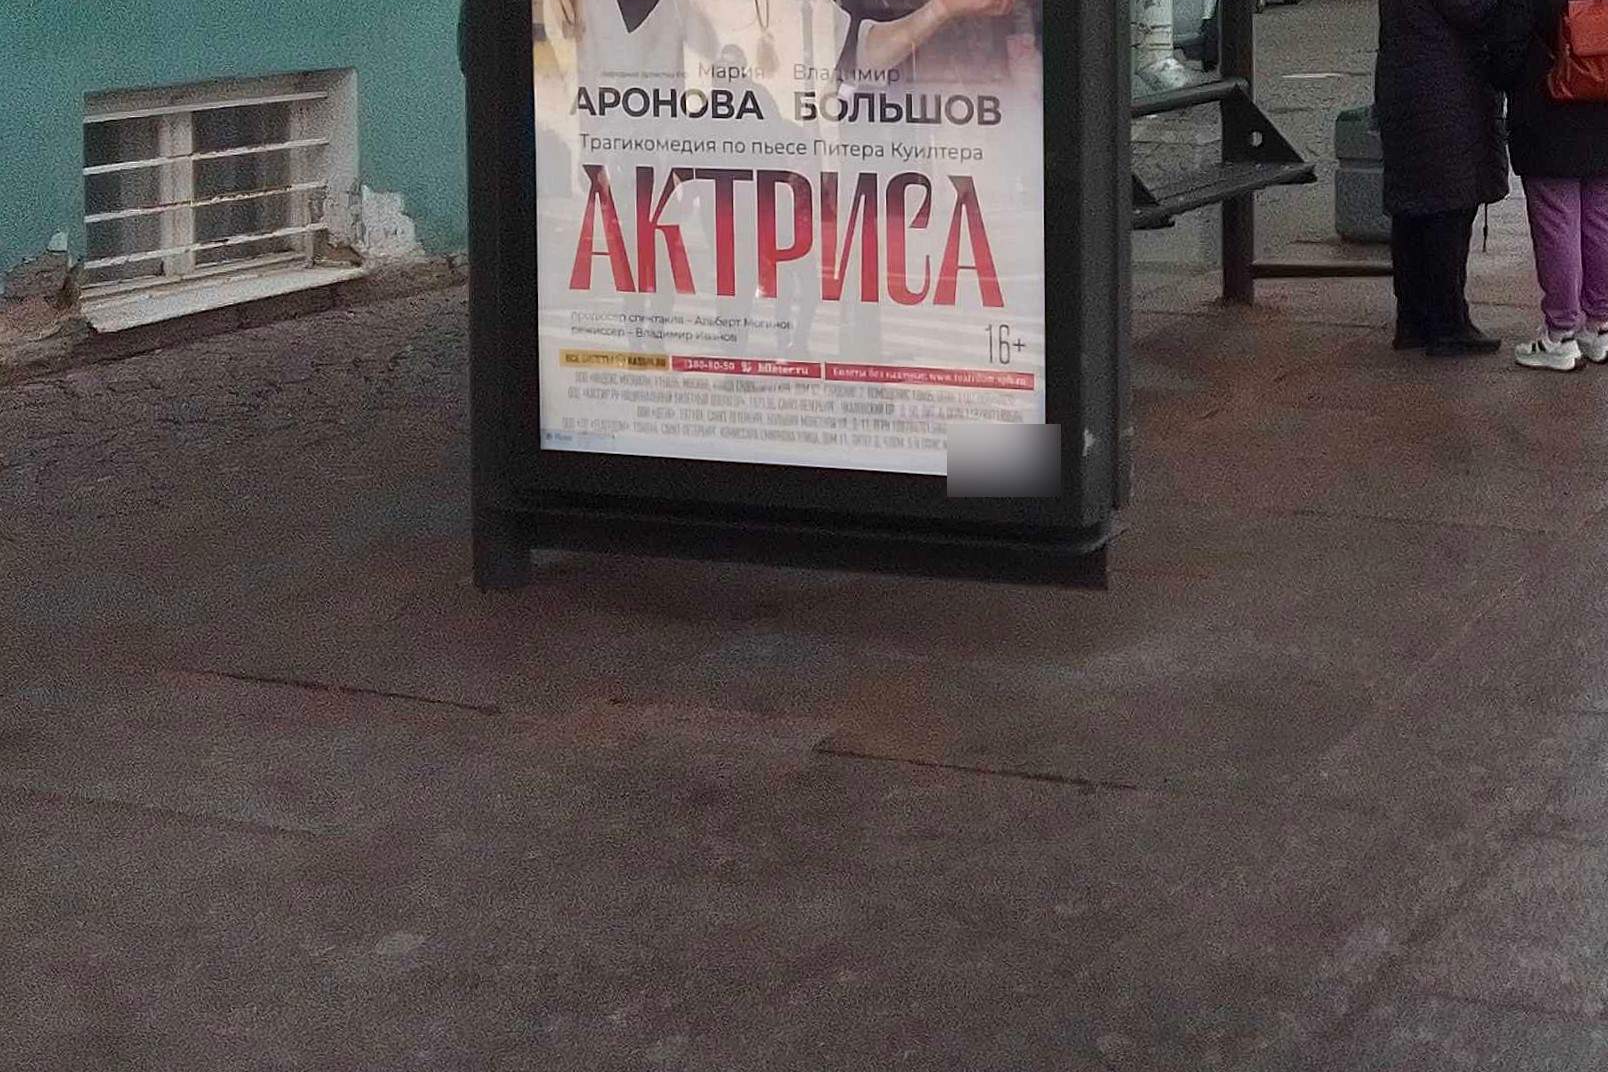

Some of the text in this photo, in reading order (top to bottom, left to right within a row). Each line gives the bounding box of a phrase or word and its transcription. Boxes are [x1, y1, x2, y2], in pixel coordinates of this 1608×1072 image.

[569, 86, 764, 120] АРОНОВА
[793, 90, 1002, 126] БОЛЬШОВ
[579, 132, 984, 162] Трагикомедия по пьесе Питера Куилтера
[568, 163, 1006, 308] АКТРИСА
[985, 324, 1026, 365] 16+
